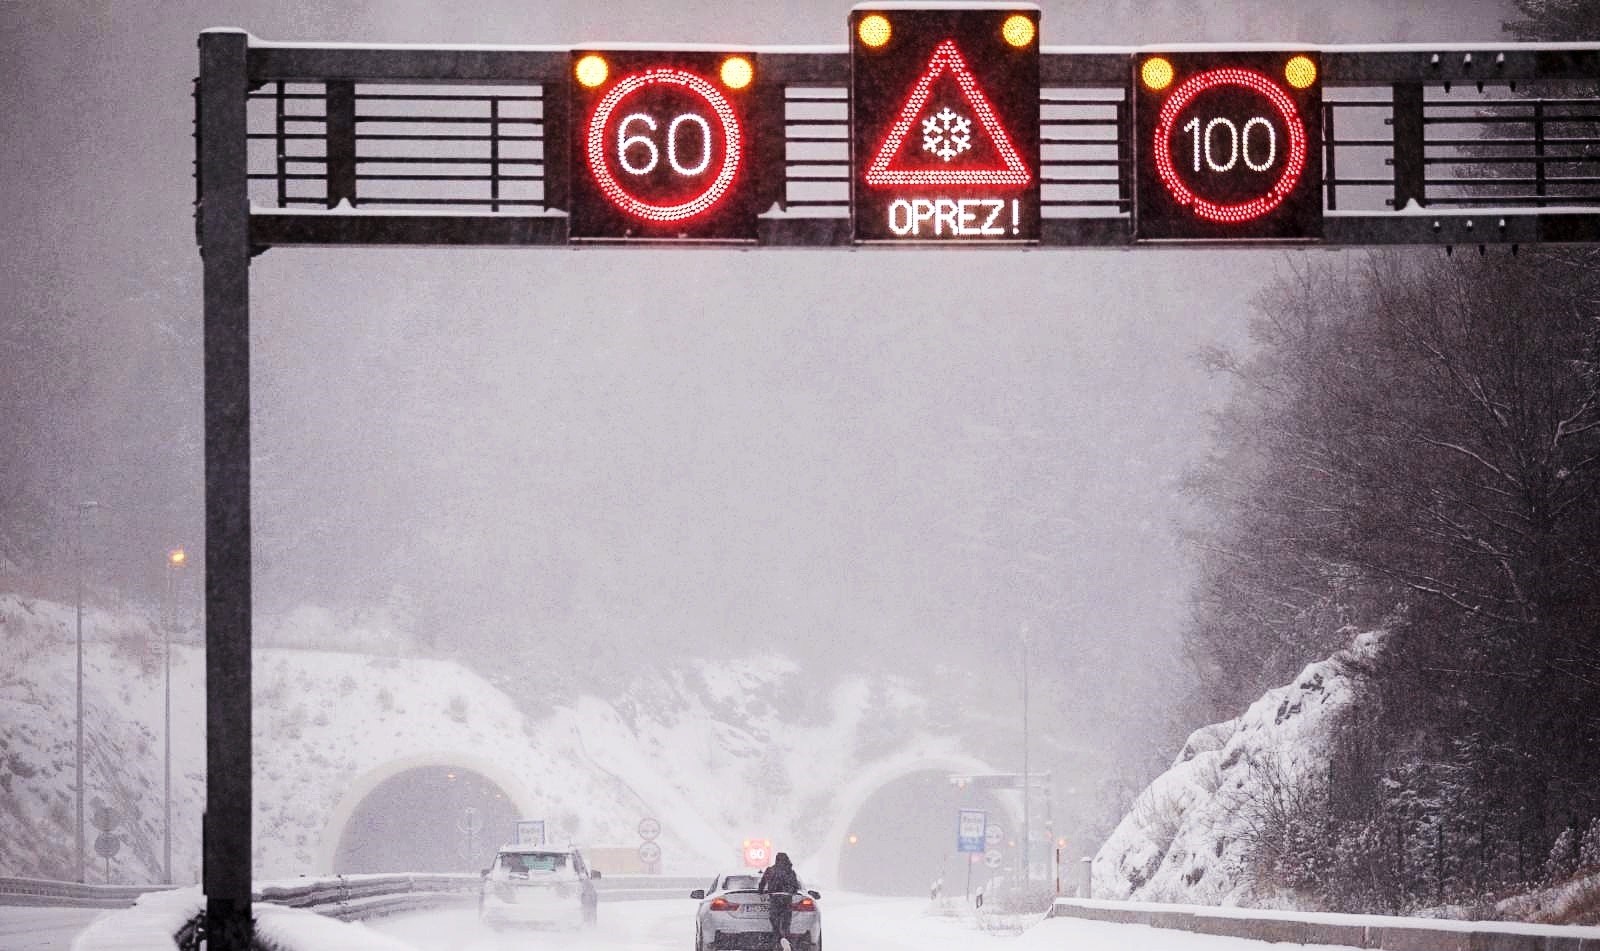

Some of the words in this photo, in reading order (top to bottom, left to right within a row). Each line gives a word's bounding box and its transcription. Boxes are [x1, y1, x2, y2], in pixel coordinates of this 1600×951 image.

[617, 113, 711, 175] 60
[1183, 117, 1276, 172] 100
[888, 198, 1020, 236] OPREZ!
